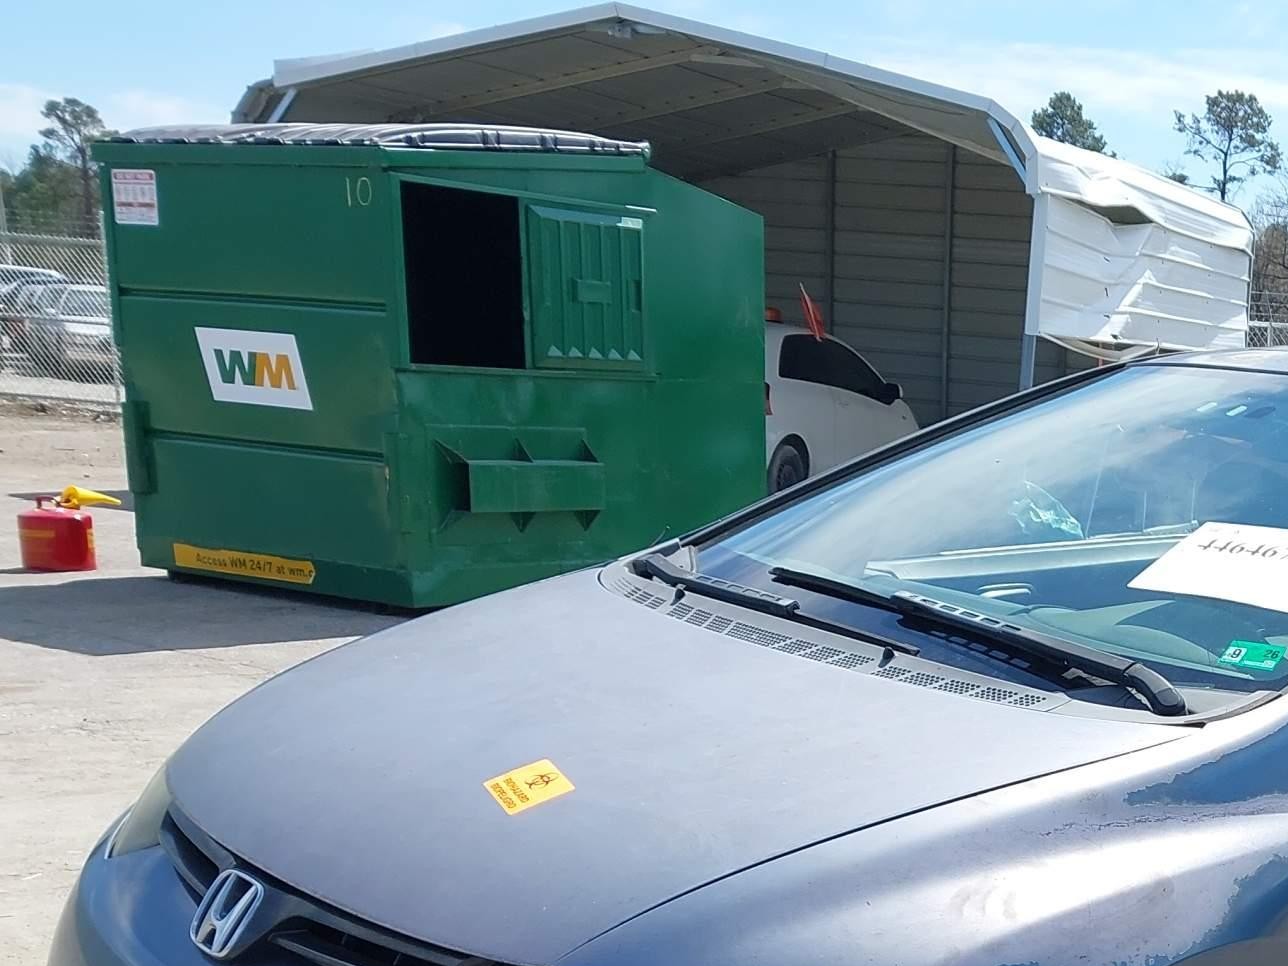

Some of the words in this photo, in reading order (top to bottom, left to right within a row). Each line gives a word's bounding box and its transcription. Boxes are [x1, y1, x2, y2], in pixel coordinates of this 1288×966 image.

[345, 176, 372, 207] 10
[213, 348, 297, 391] WM
[194, 552, 227, 568] Access
[229, 556, 248, 570] WM
[250, 559, 273, 574] 24/7
[276, 565, 286, 576] at
[1230, 648, 1242, 659] 9
[1264, 649, 1281, 660] 26
